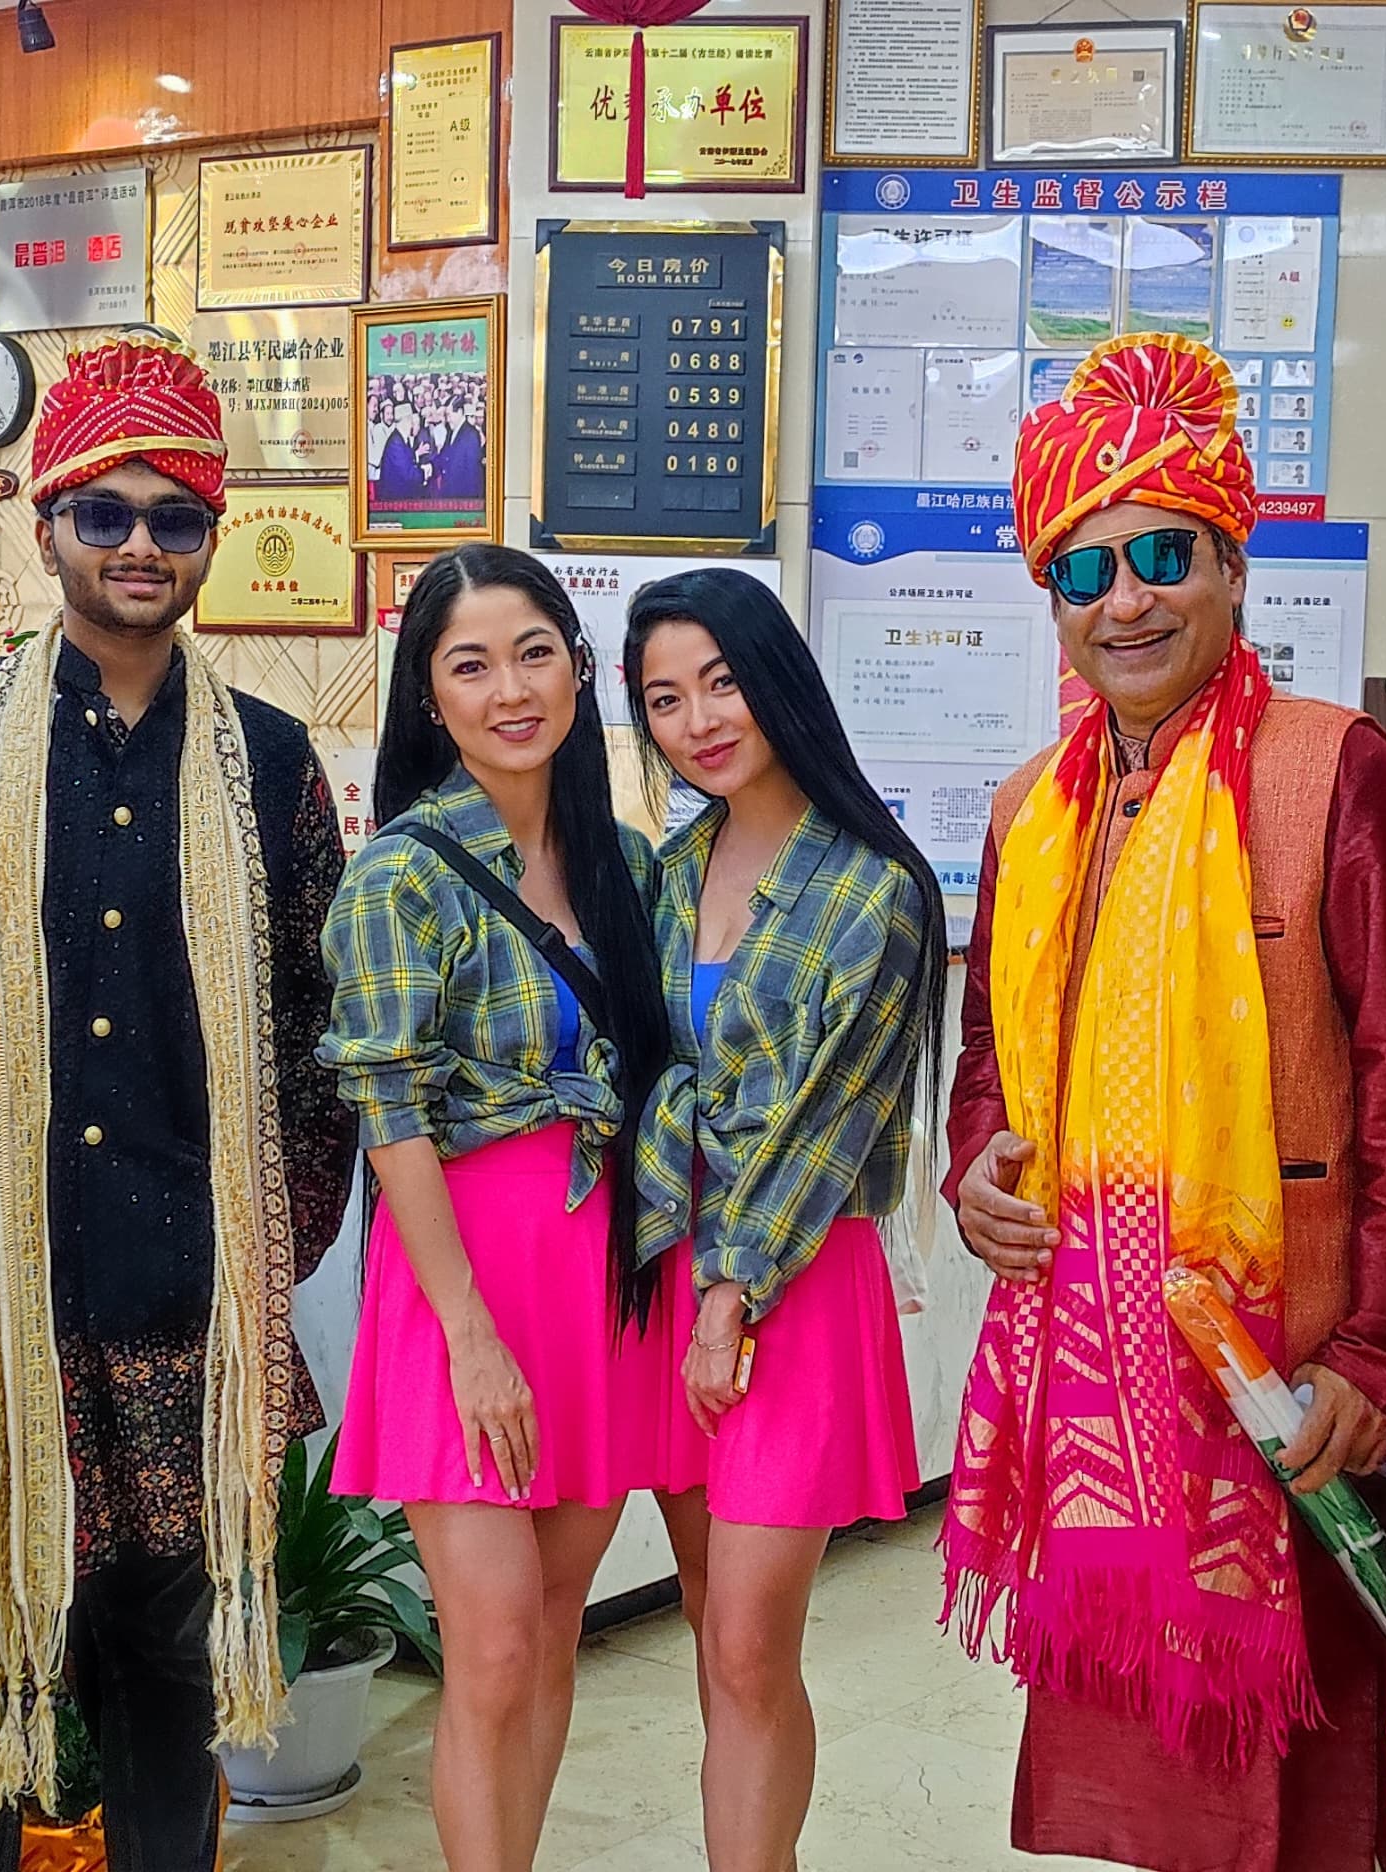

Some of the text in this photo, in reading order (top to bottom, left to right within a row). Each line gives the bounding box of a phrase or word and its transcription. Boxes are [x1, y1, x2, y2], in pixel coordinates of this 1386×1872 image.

[951, 178, 1228, 210] 卫生监督公示栏
[87, 234, 123, 262] 酒店
[608, 258, 710, 273] 今日房价
[617, 275, 700, 284] ROOM RATE
[1278, 271, 1301, 282] A级
[671, 319, 741, 336] 0791
[207, 337, 345, 362] 墨江县军民融合企业
[669, 353, 741, 370] 0688
[669, 387, 740, 404] 0539
[668, 421, 739, 439] 0480
[667, 455, 738, 472] 0180
[1257, 501, 1316, 514] 4239497
[217, 506, 342, 545] 江哈尼族自治县酒店协会
[250, 580, 300, 592] 会长单位
[889, 588, 974, 599] 公共场所卫生许可证
[884, 629, 984, 647] 卫生许可证
